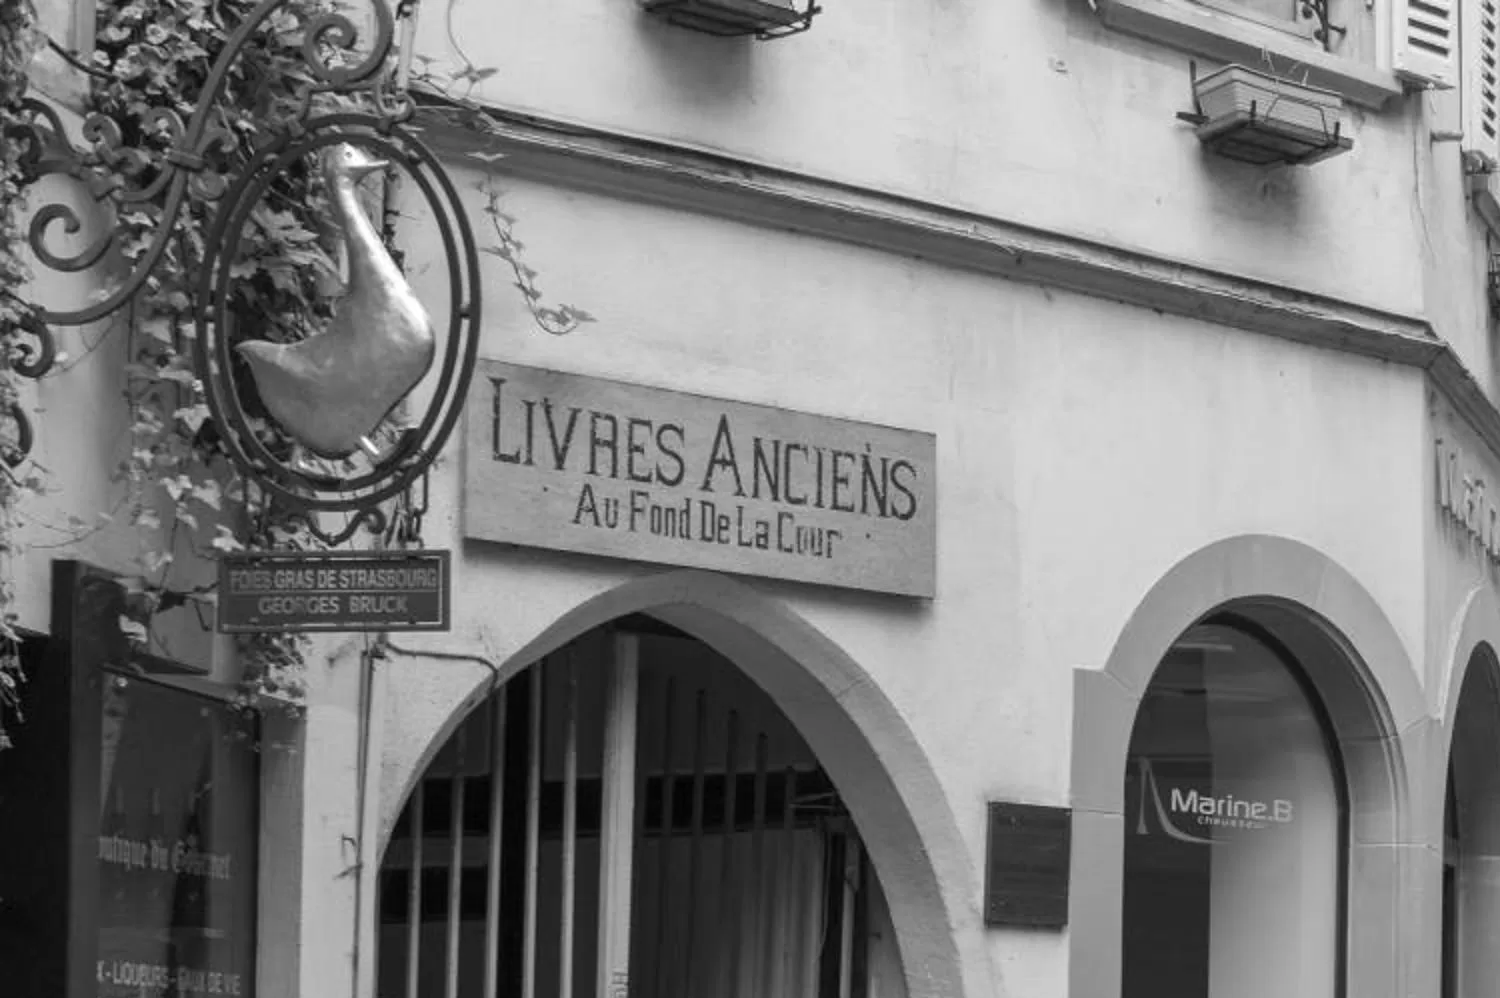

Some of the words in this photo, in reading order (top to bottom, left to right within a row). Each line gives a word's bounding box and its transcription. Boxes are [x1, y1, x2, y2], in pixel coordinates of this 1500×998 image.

[487, 376, 685, 487] LIVRES
[698, 413, 917, 521] ANCIENS
[571, 483, 618, 529] Au
[628, 490, 691, 540] Fond
[699, 500, 731, 545] De
[736, 505, 769, 550] La
[777, 511, 843, 558] Cour
[229, 569, 272, 589] FOIES
[274, 569, 315, 589] GRAS
[317, 569, 337, 589] DE
[339, 568, 437, 589] STRASBOURG
[258, 596, 340, 615] GEORGES
[350, 595, 408, 614] BRUCK
